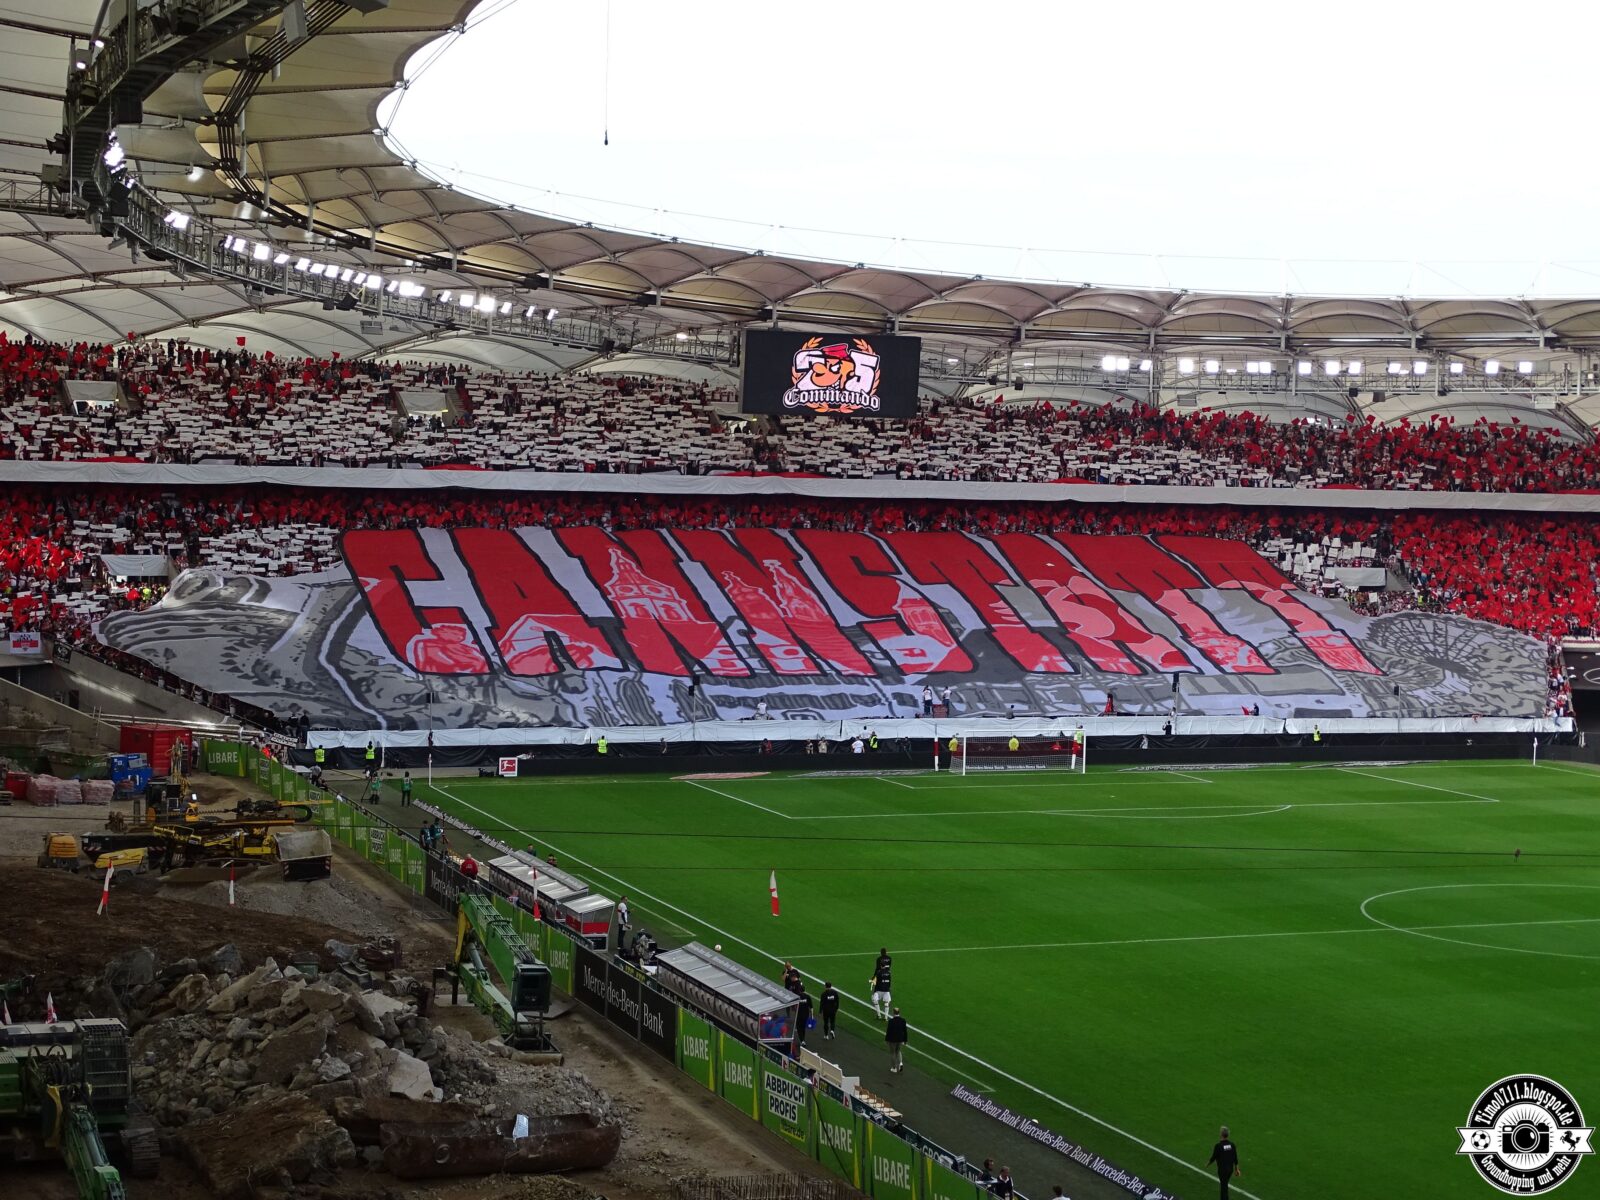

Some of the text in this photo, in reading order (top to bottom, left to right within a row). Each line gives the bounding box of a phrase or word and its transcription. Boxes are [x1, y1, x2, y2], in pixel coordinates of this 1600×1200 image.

[783, 388, 881, 412] Commando
[341, 527, 1383, 677] CANNSTATT
[208, 751, 239, 764] LIBARE
[550, 950, 569, 970] LIBARE
[583, 965, 639, 1021] Mercedes-Benz
[643, 1002, 664, 1039] Bank
[683, 1034, 710, 1061] LIBARE
[724, 1060, 753, 1089] LIBARE
[765, 1074, 805, 1104] ABBRUCH
[769, 1095, 798, 1122] PROFIS
[819, 1121, 853, 1153] LIBARE
[950, 1083, 1002, 1117] Mercedes-Benz
[998, 1108, 1021, 1128] Bank
[1016, 1118, 1074, 1154] Mercedes-Benz
[1070, 1145, 1094, 1167] Bank
[873, 1154, 911, 1190] LIBARE
